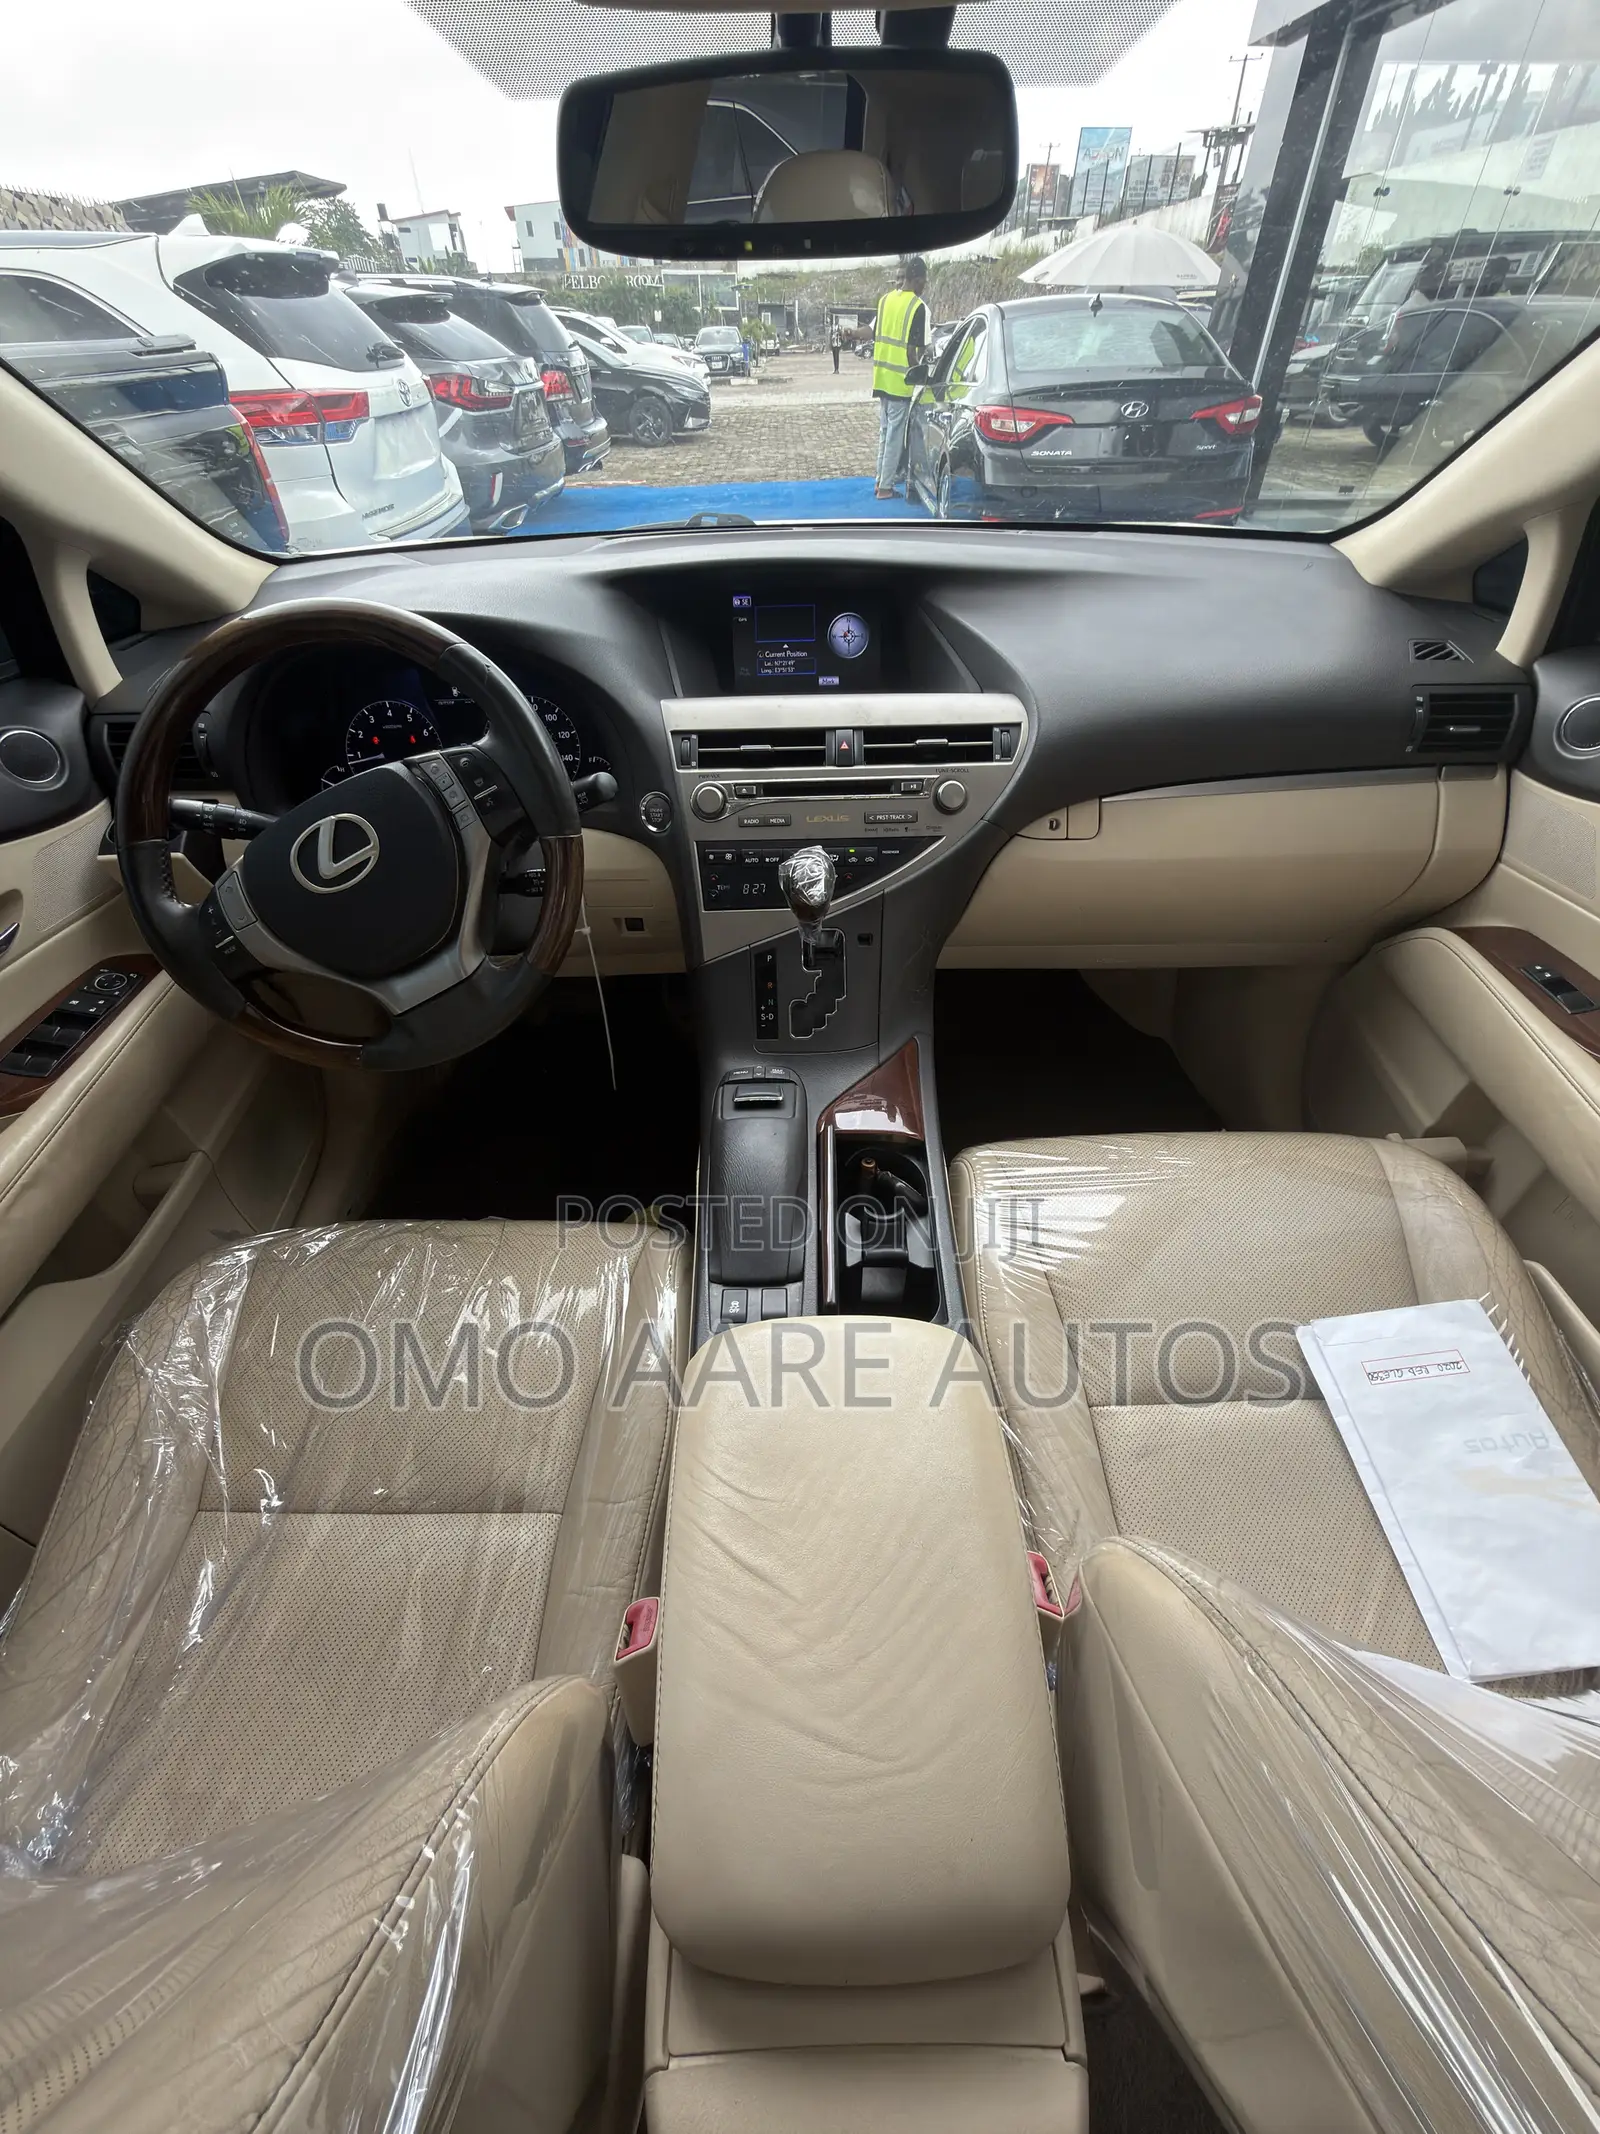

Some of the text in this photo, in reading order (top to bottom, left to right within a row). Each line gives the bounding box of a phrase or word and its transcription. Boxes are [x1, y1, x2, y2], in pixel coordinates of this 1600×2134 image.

[765, 650, 807, 658] Current Position
[369, 715, 375, 723] 3
[407, 714, 412, 722] 5
[545, 713, 557, 721] 100
[358, 730, 363, 738] 2
[558, 731, 570, 739] 120
[806, 815, 850, 823] LEXUS
[1408, 1365, 1430, 1376] RED
[1437, 1361, 1462, 1372] 2020
